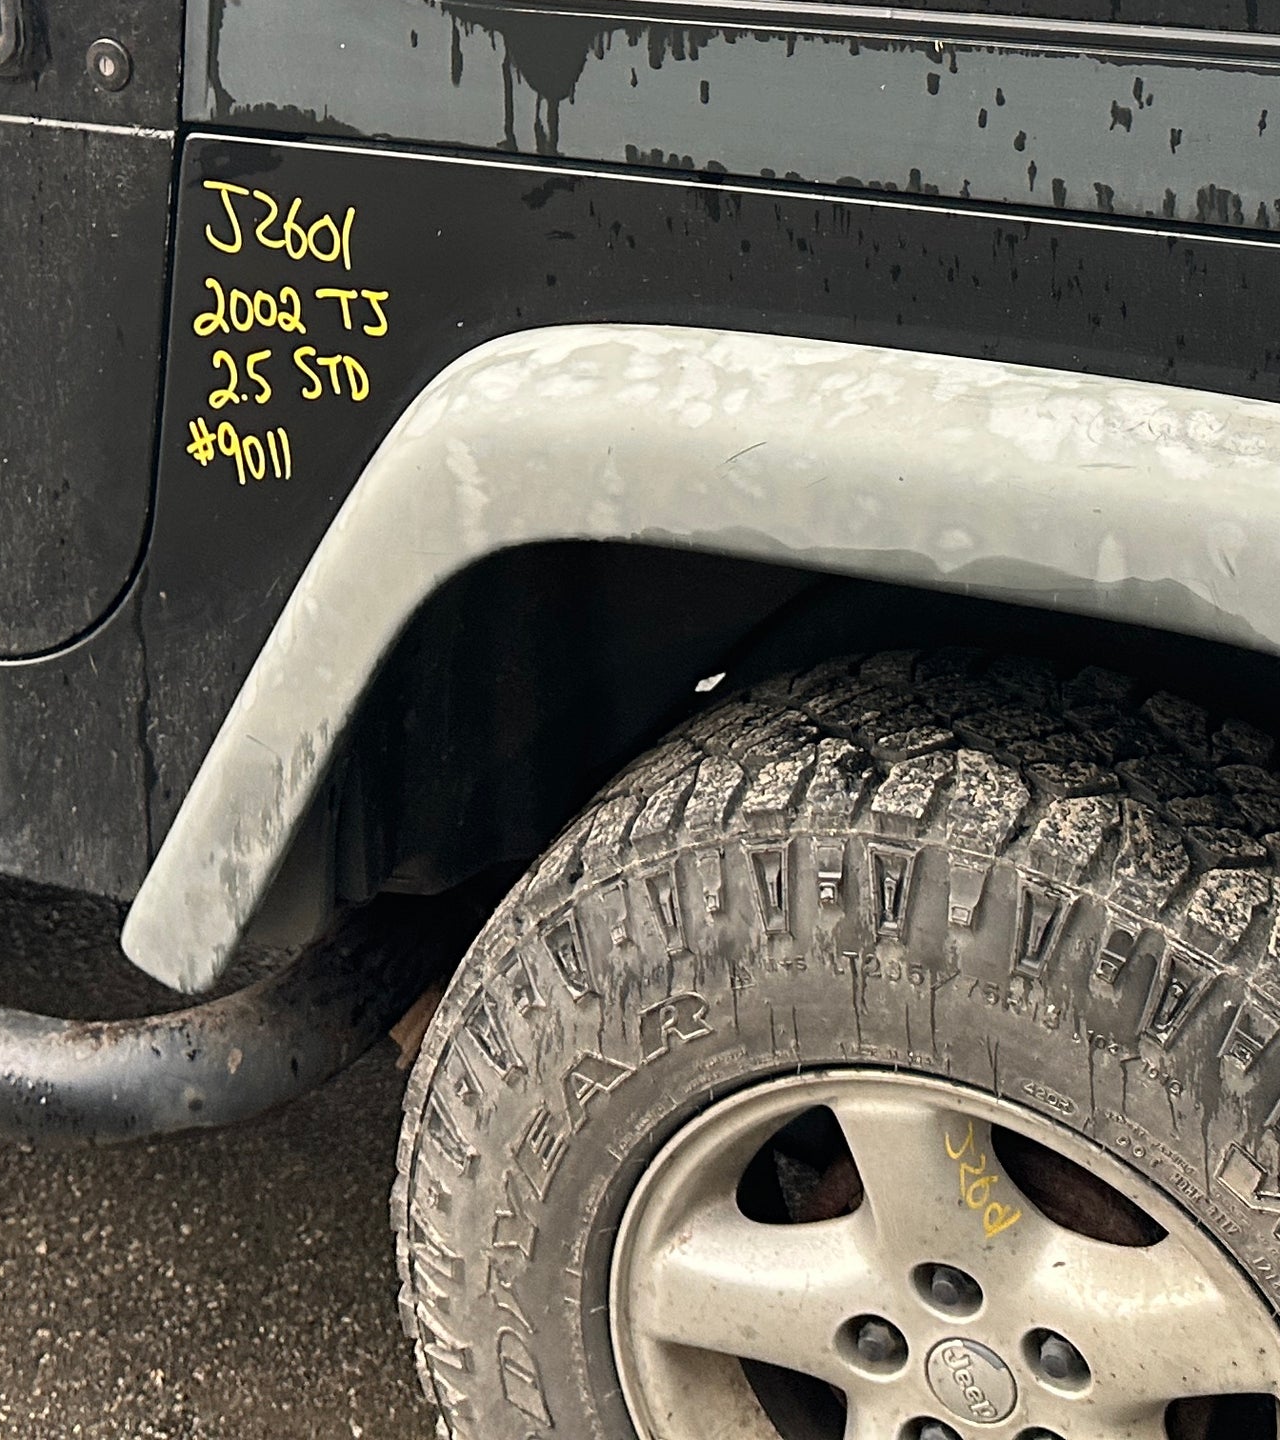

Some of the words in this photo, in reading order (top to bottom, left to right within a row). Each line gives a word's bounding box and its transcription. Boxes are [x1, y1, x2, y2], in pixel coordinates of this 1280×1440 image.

[203, 179, 356, 271] J2601
[193, 277, 308, 337] 2002
[315, 288, 390, 337] TJ
[208, 349, 272, 409] 2.5
[293, 345, 371, 402] STD
[186, 417, 291, 485] #9011
[482, 989, 716, 1440] DYEAR
[941, 1345, 998, 1421] Jeep
